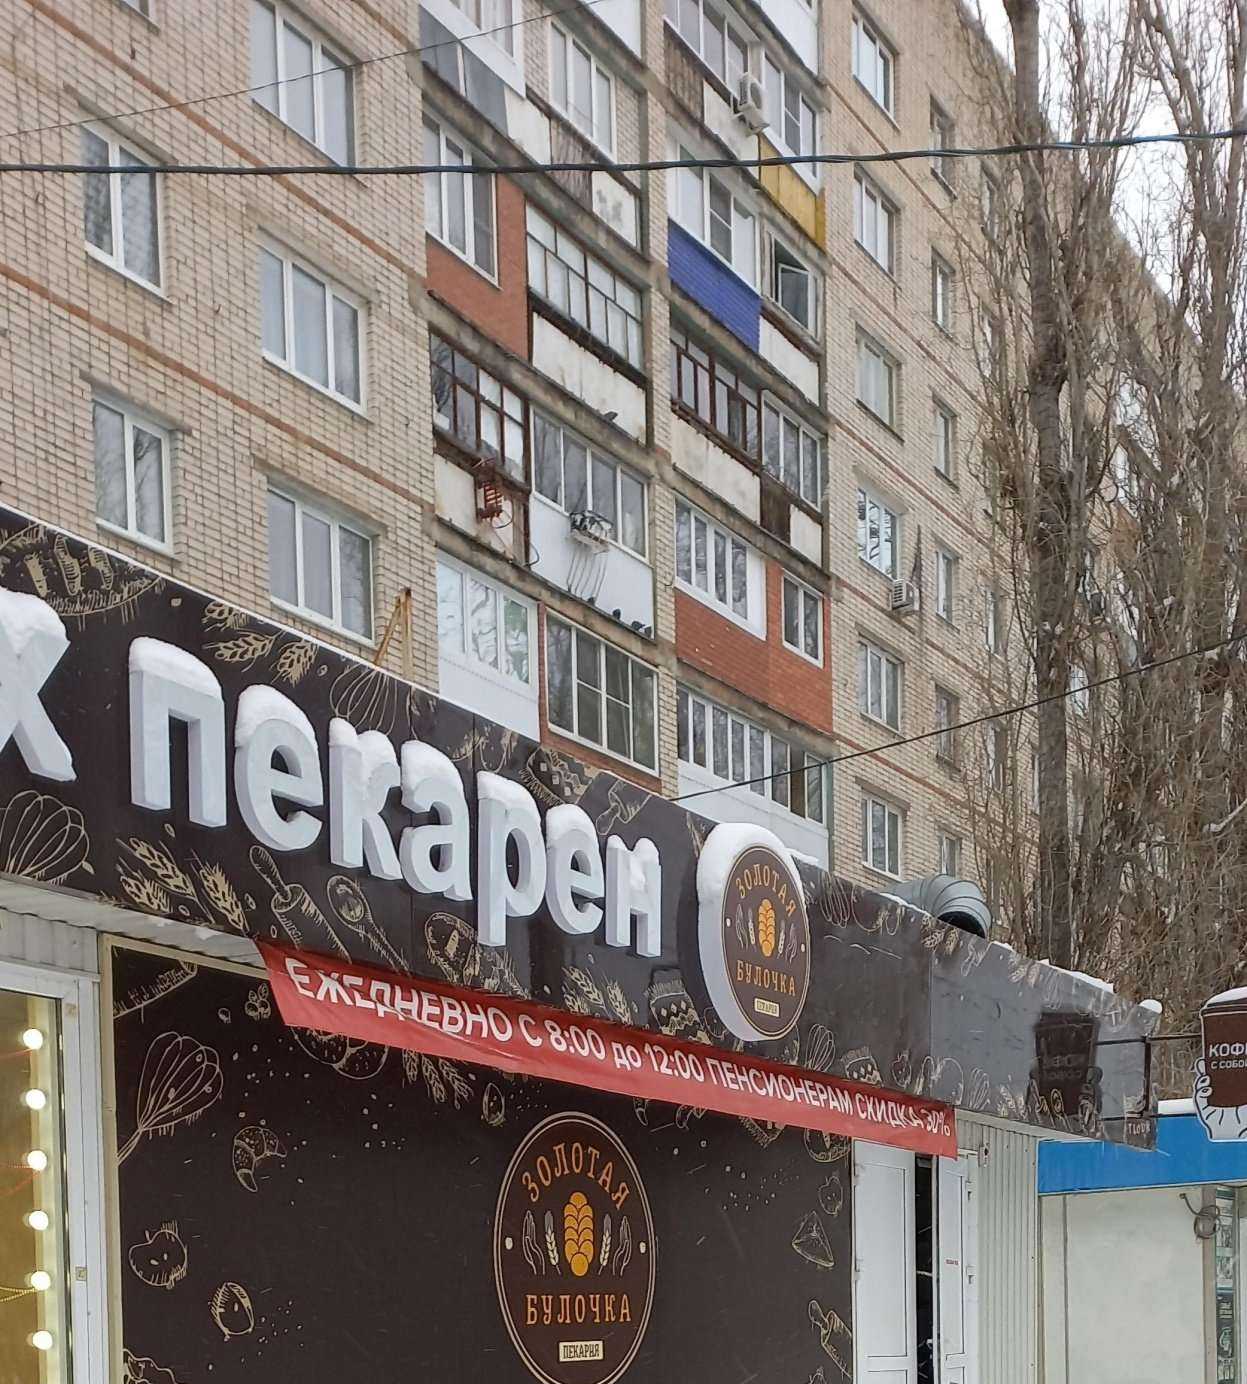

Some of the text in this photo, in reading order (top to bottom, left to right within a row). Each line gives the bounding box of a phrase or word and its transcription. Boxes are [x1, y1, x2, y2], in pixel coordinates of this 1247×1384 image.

[128, 637, 662, 957] пекарен
[735, 863, 797, 918] ЗОЛОТАЯ
[736, 959, 796, 997] БУЛОЧКА
[285, 957, 952, 1138] ЕЖЕДНЕВНО С 8:00 до 12:00 ПЕНСИОНЕРАМ СКИДКА 30%
[1209, 1042, 1247, 1058] КОФ
[1211, 1061, 1218, 1070] С
[521, 1142, 630, 1211] ЗОЛОТАЯ
[525, 1294, 631, 1326] БУЛОЧКА
[562, 1341, 600, 1360] ПЕКАРНЯ
